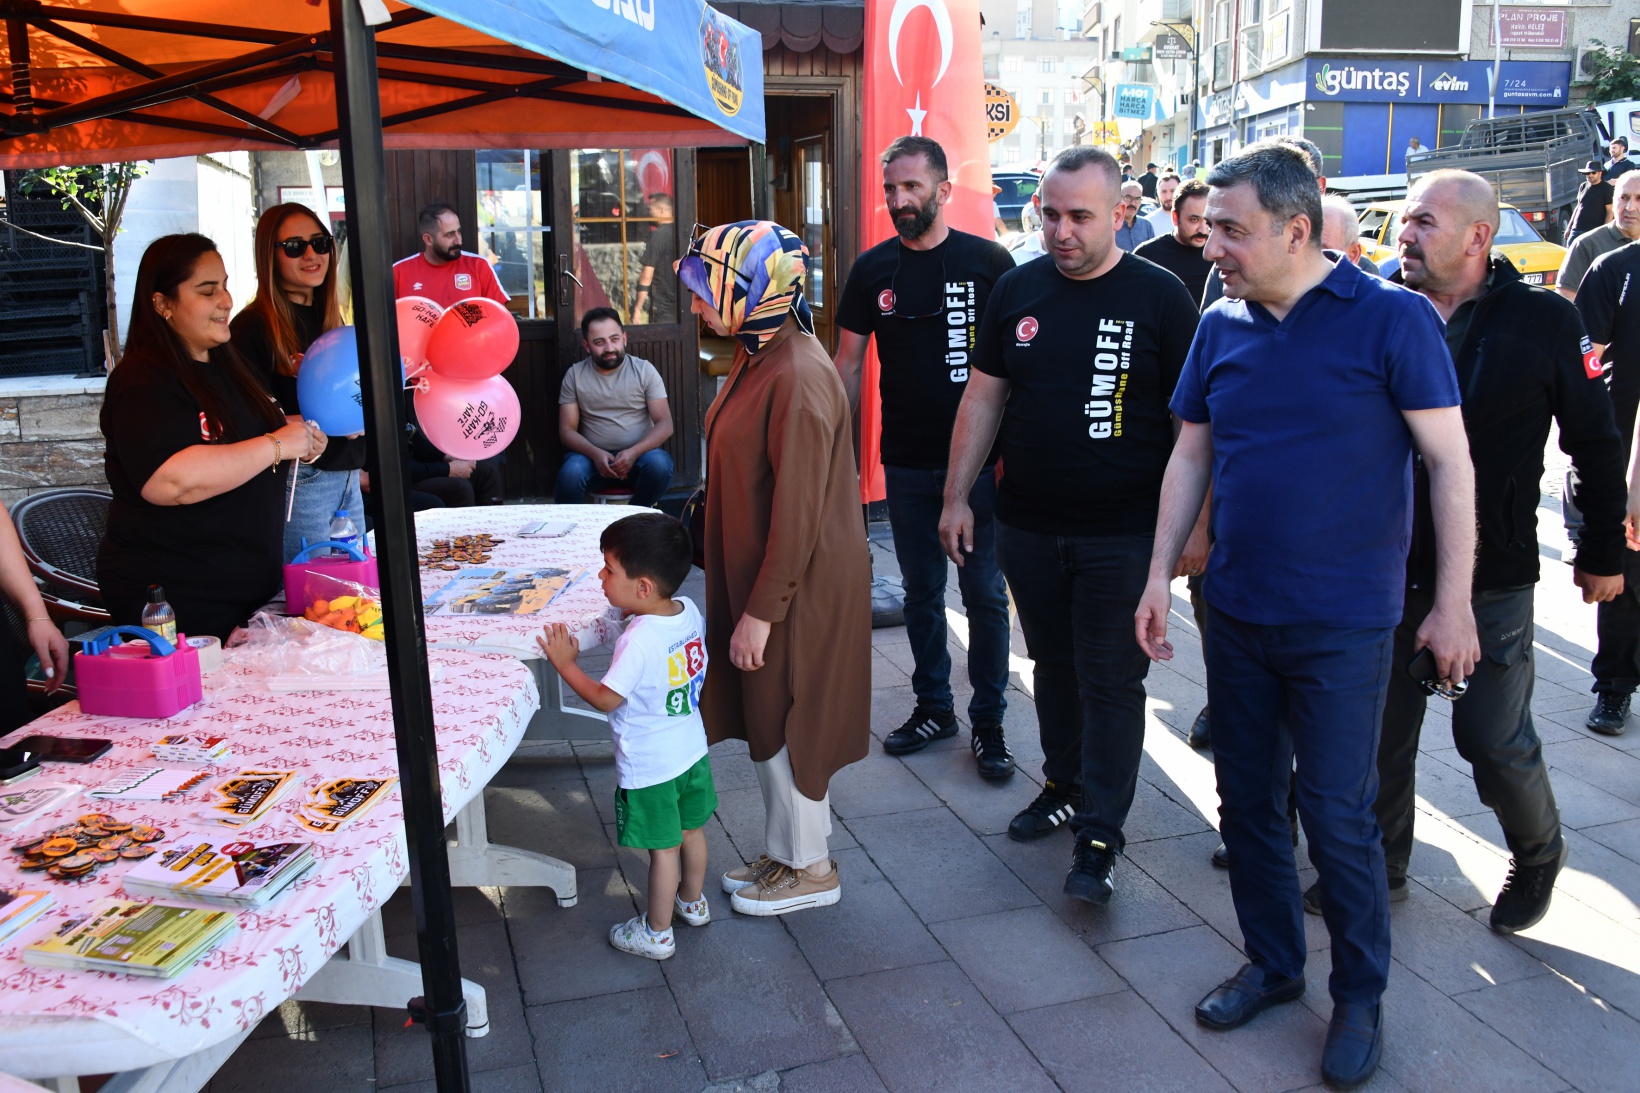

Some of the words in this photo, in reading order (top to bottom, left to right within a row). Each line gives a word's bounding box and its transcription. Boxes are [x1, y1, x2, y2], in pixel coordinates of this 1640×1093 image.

[1499, 13, 1524, 21] PLAN
[1527, 13, 1559, 22] PROJE
[1326, 66, 1410, 97] güntaş
[1504, 80, 1526, 88] 7/24
[1119, 102, 1146, 110] HARCA
[1120, 96, 1146, 104] HARCA
[966, 281, 976, 306] Road
[945, 281, 969, 383] GÜMOFF
[1121, 320, 1135, 350] Road
[1120, 351, 1131, 370] Off
[1084, 318, 1123, 439] GÜMOFF
[456, 402, 475, 428] KAFE
[462, 400, 489, 440] GO-KART
[668, 630, 698, 654] ESTABLISHED
[237, 785, 269, 814] GÜMOFF
[332, 787, 371, 817] GÜMOFF
